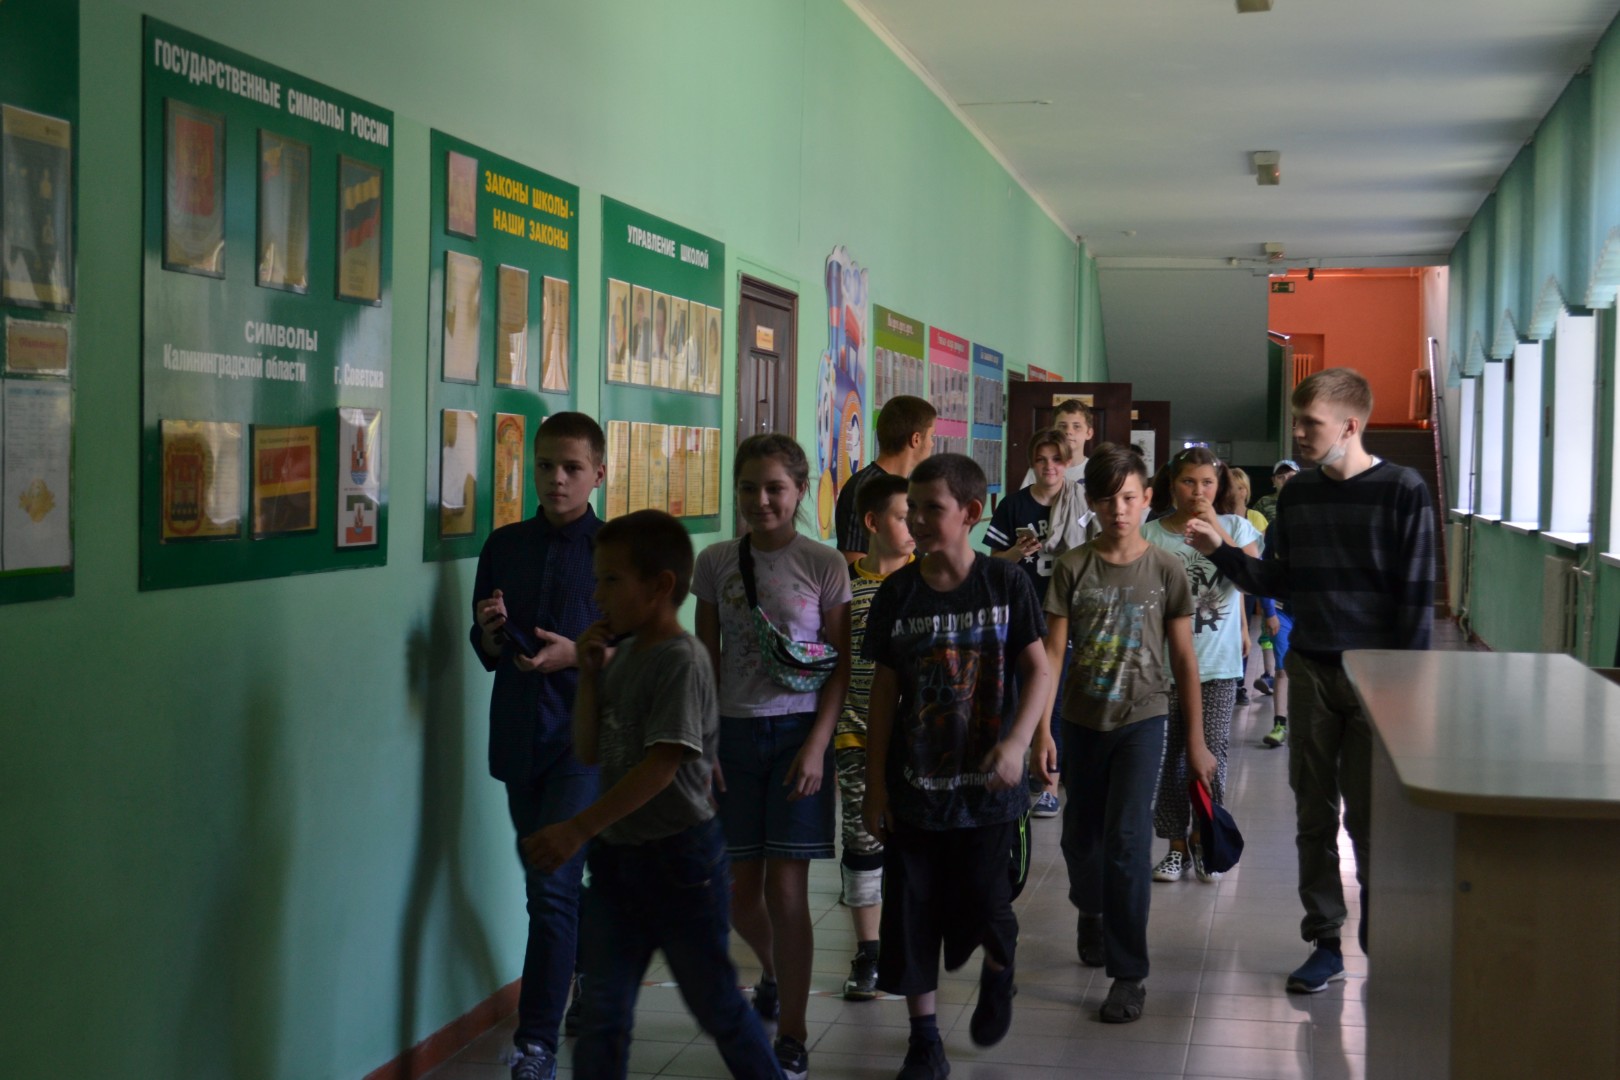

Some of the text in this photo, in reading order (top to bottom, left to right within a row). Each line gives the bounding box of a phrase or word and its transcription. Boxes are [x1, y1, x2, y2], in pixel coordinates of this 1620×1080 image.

[155, 38, 389, 147] ГОСУДАРСТВЕННЫЕ СИМВОЛЫ РОССИИ
[485, 170, 528, 205] ЗАКОНЫ
[493, 208, 568, 250] НАШИ ЗАКОНЫ
[627, 224, 709, 269] УПРАВЛЕНИЕ ШКОЛОЙ
[244, 320, 318, 352] СИМВОЛЫ
[163, 343, 307, 382] Калининградской области
[333, 366, 342, 385] г.
[907, 611, 974, 634] ХОРОШУЮ
